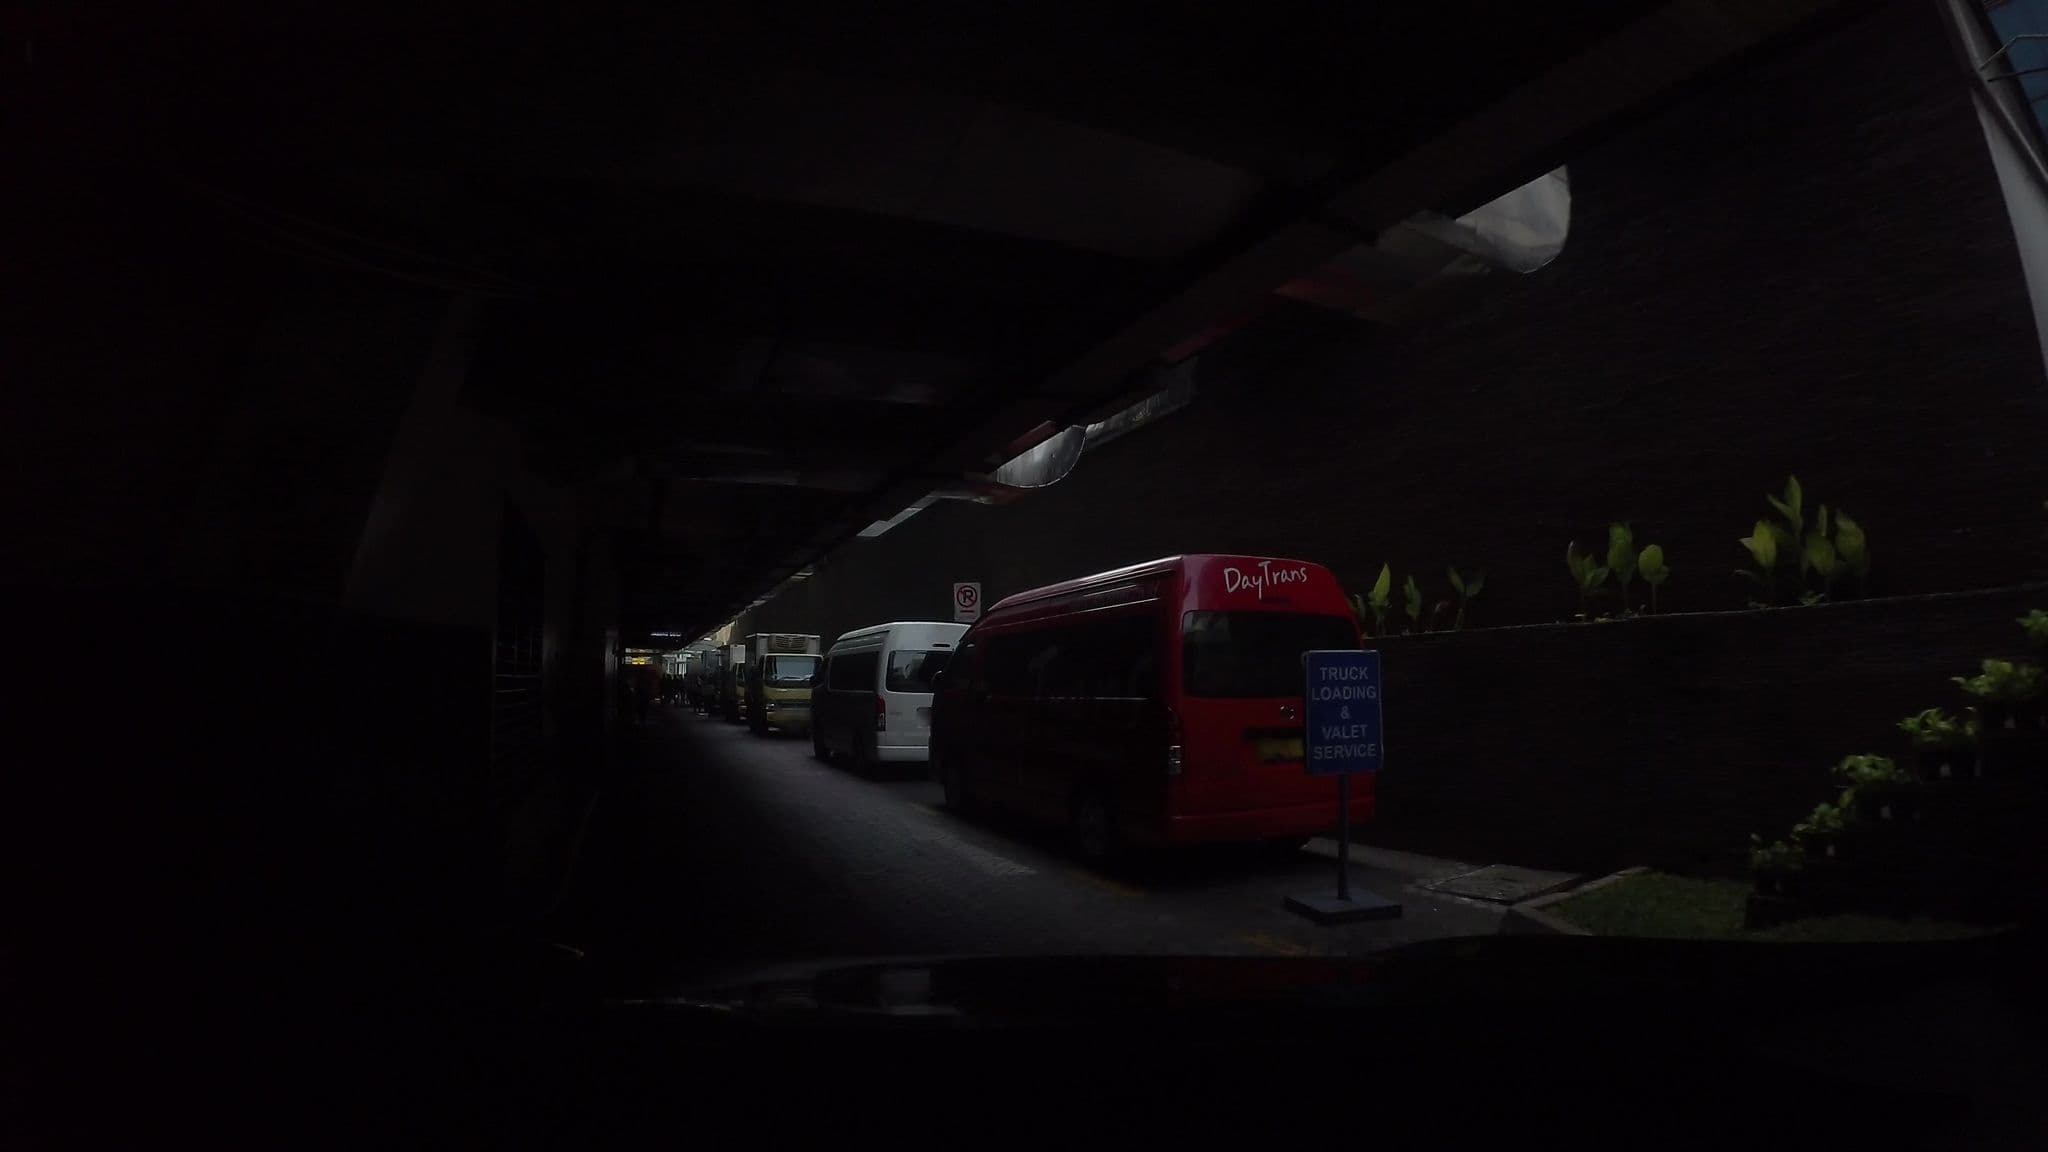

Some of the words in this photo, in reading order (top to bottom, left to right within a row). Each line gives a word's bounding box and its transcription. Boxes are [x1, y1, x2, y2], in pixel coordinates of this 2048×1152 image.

[1224, 561, 1308, 599] DayTrans
[1319, 666, 1369, 681] TRUCK
[1311, 686, 1377, 701] LOADING
[1340, 706, 1351, 719] &
[1321, 724, 1369, 740] VALET
[1312, 744, 1377, 760] SERVICE
